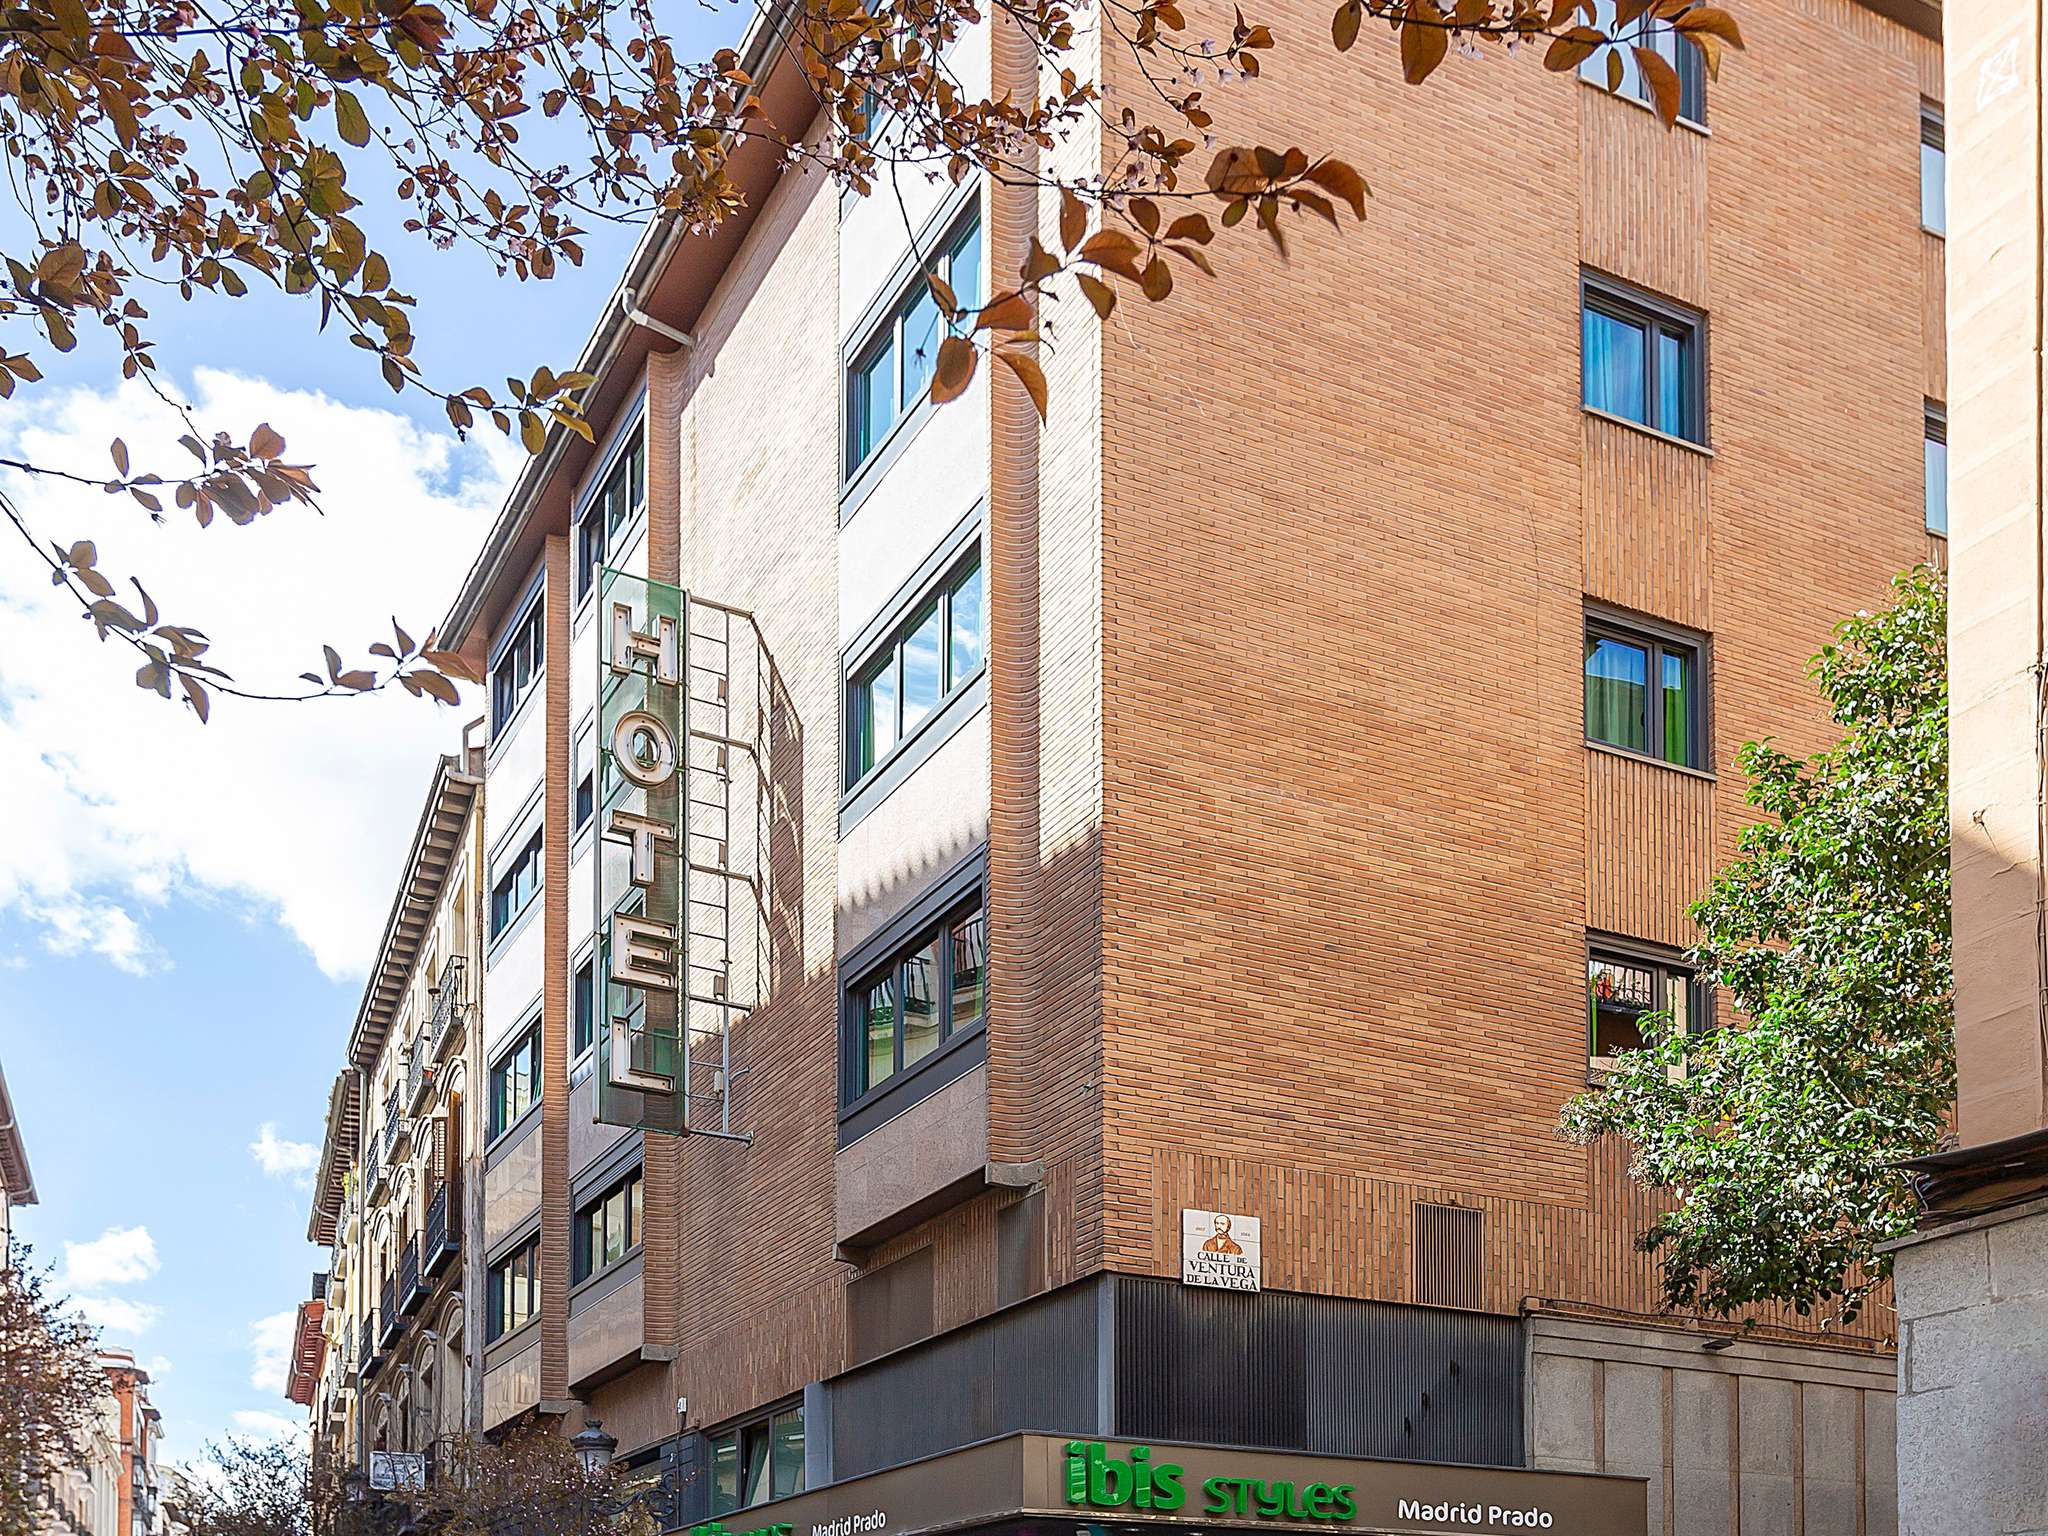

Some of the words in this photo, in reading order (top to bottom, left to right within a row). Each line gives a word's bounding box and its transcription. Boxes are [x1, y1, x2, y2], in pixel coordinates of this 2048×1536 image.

[607, 602, 678, 1094] HOTEL
[1189, 1261, 1255, 1278] VENTURA
[1197, 1252, 1230, 1262] CALLE
[1236, 1256, 1248, 1264] DE
[1186, 1274, 1202, 1284] DE
[1219, 1276, 1258, 1291] VEGA
[1064, 1440, 1187, 1510] ibis
[811, 1518, 851, 1536] Madrid
[853, 1509, 886, 1533] Prado
[1398, 1500, 1482, 1525] Madrid
[1488, 1505, 1553, 1528] Prado
